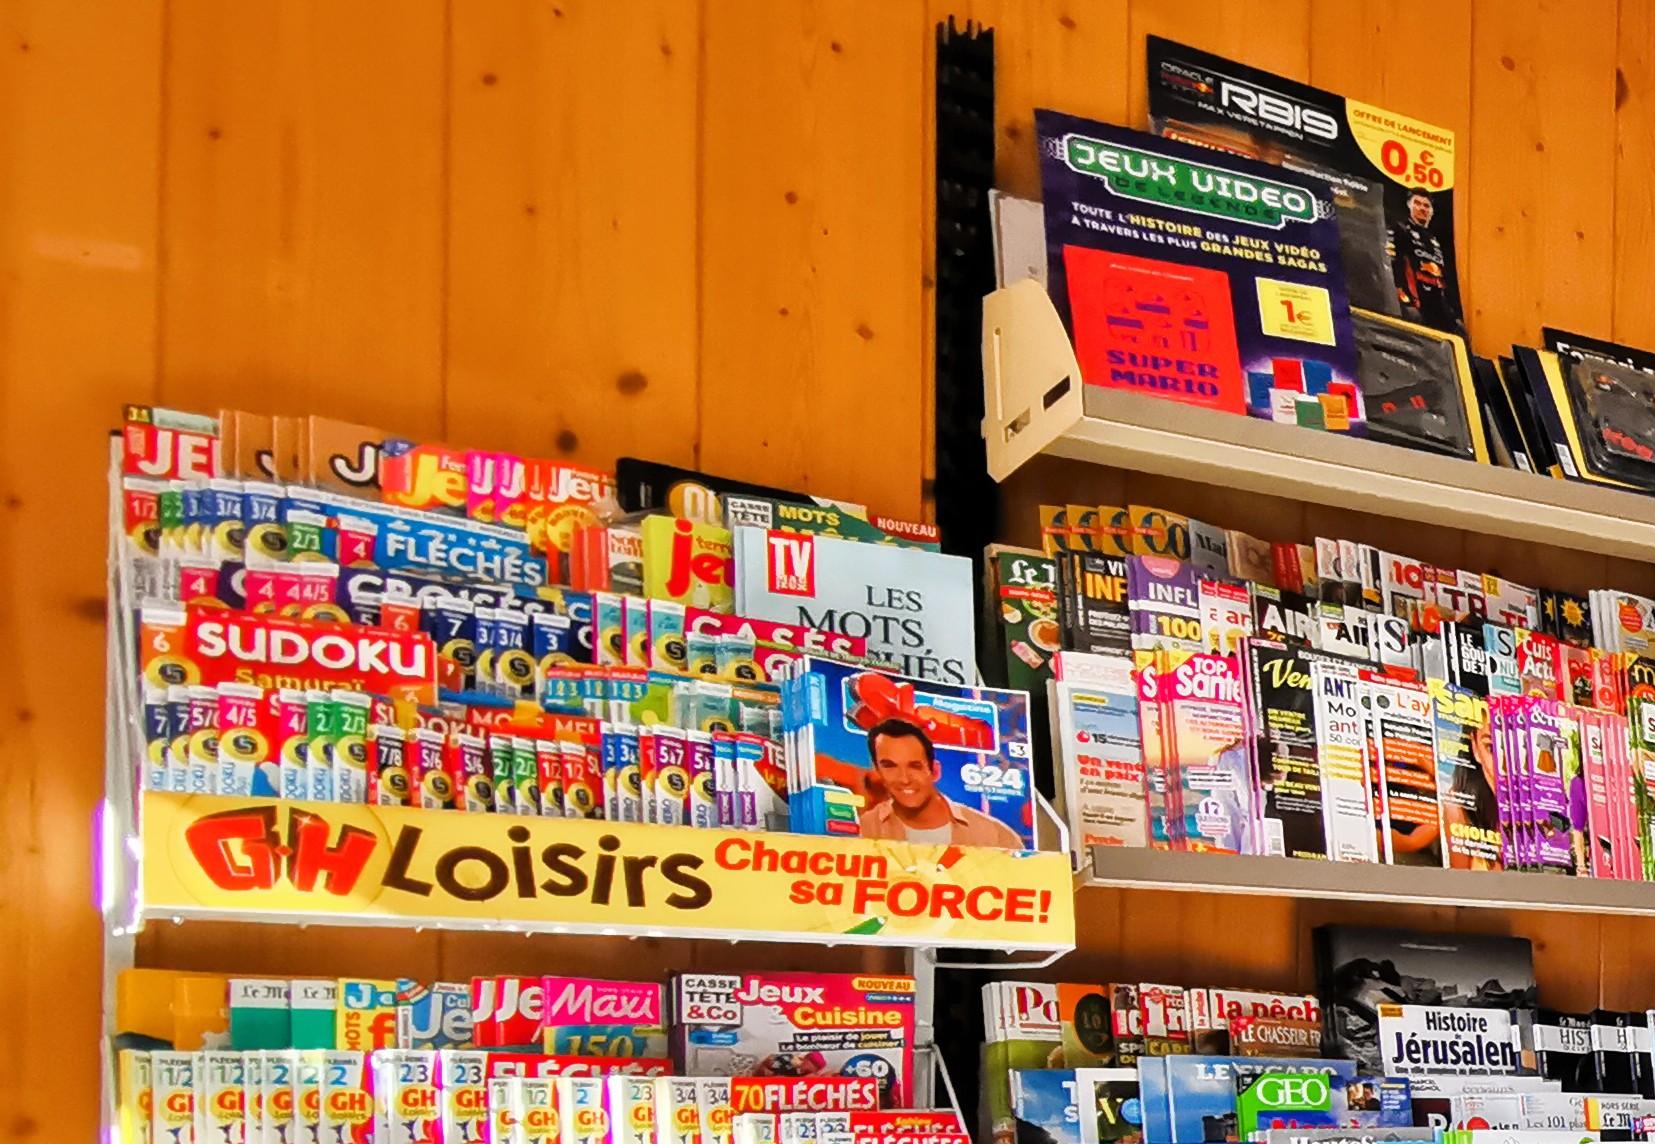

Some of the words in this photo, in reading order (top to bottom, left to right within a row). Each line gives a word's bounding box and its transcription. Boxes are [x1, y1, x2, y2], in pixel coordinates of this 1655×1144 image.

[1221, 81, 1338, 140] RB19
[1353, 109, 1381, 123] OFFRE
[1384, 118, 1396, 128] DE
[1398, 124, 1452, 147] LANCEMENT
[1073, 142, 1176, 185] JEUX
[1192, 169, 1306, 214] VIDEO
[1072, 201, 1113, 222] TOUTE
[1118, 214, 1202, 238] L'HISTOIRE
[1206, 231, 1229, 244] DES
[1232, 234, 1269, 250] JEUX
[1274, 242, 1320, 260] VIDÉO
[1084, 220, 1140, 240] TRAVERS
[1142, 232, 1164, 244] LES
[1168, 236, 1198, 250] PLUS
[1200, 241, 1273, 264] GRANDES
[1278, 255, 1328, 272] SAGAS
[1107, 350, 1219, 379] SUPER
[1110, 369, 1219, 397] MARIO
[778, 504, 840, 526] MOTS
[877, 517, 937, 538] NOUVEAU
[769, 537, 812, 578] TV
[866, 585, 923, 612] LES
[798, 606, 925, 648] MOTS
[197, 622, 426, 678] SUDOKU
[1193, 657, 1228, 675] TOP
[234, 668, 366, 693] Samuraï
[959, 763, 1023, 789] 624
[380, 823, 714, 910] Loisirs
[715, 837, 888, 879] Chacun
[789, 879, 842, 906] sa
[852, 879, 1053, 924] FORCE!
[685, 976, 738, 991] CASSE
[738, 979, 825, 1005] Jeux
[856, 977, 911, 991] NOUVEAU
[551, 982, 656, 1023] Maxi
[686, 991, 737, 1005] TÊTE
[1216, 995, 1243, 1019] la
[793, 1006, 902, 1027] Cuisine
[1424, 1010, 1488, 1034] Histoire
[1195, 1064, 1229, 1080] LE
[734, 1084, 763, 1110] 70
[764, 1080, 876, 1111] FLÉCHÉS
[1256, 1078, 1328, 1107] GEO
[1527, 1119, 1544, 1128] Les
[1548, 1116, 1566, 1128] 101
